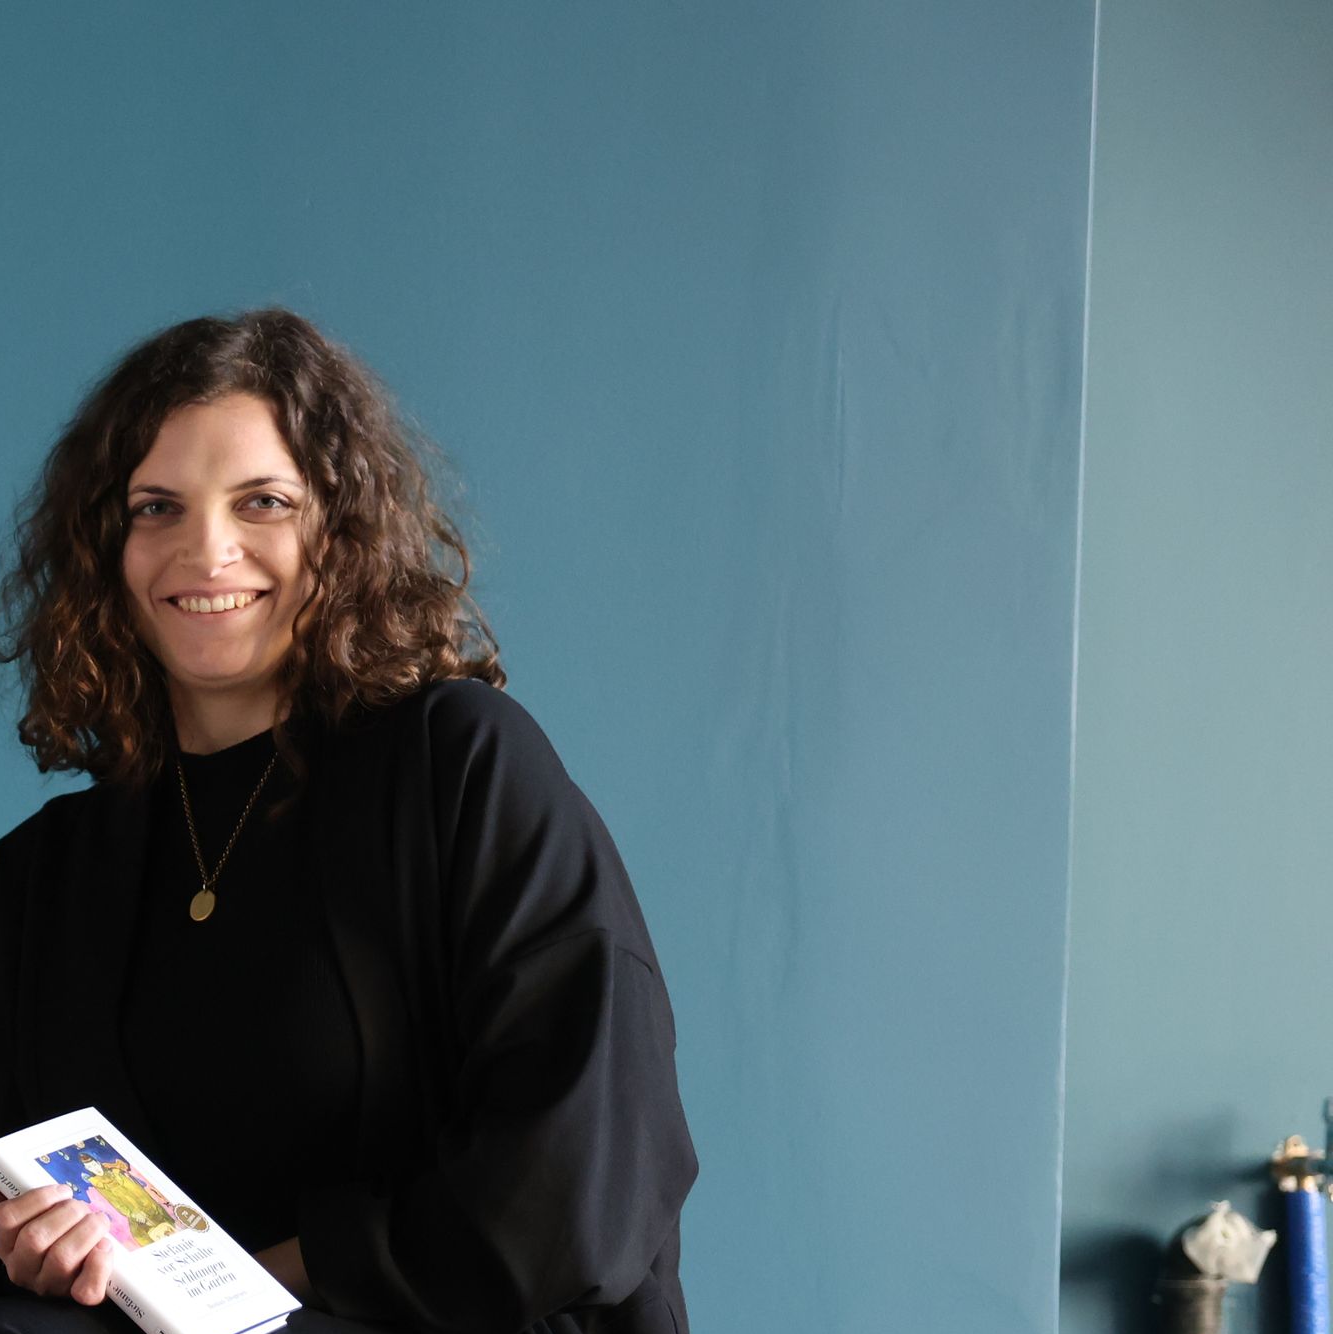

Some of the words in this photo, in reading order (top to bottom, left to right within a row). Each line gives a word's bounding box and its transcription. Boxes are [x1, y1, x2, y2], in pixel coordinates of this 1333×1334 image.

[152, 1239, 195, 1261] Stefanie
[157, 1262, 177, 1276] vor
[174, 1246, 214, 1269] Schulte
[173, 1260, 227, 1288] Schlangen
[185, 1287, 202, 1298] im
[200, 1272, 237, 1292] Garten
[114, 1286, 146, 1320] Stefanie
